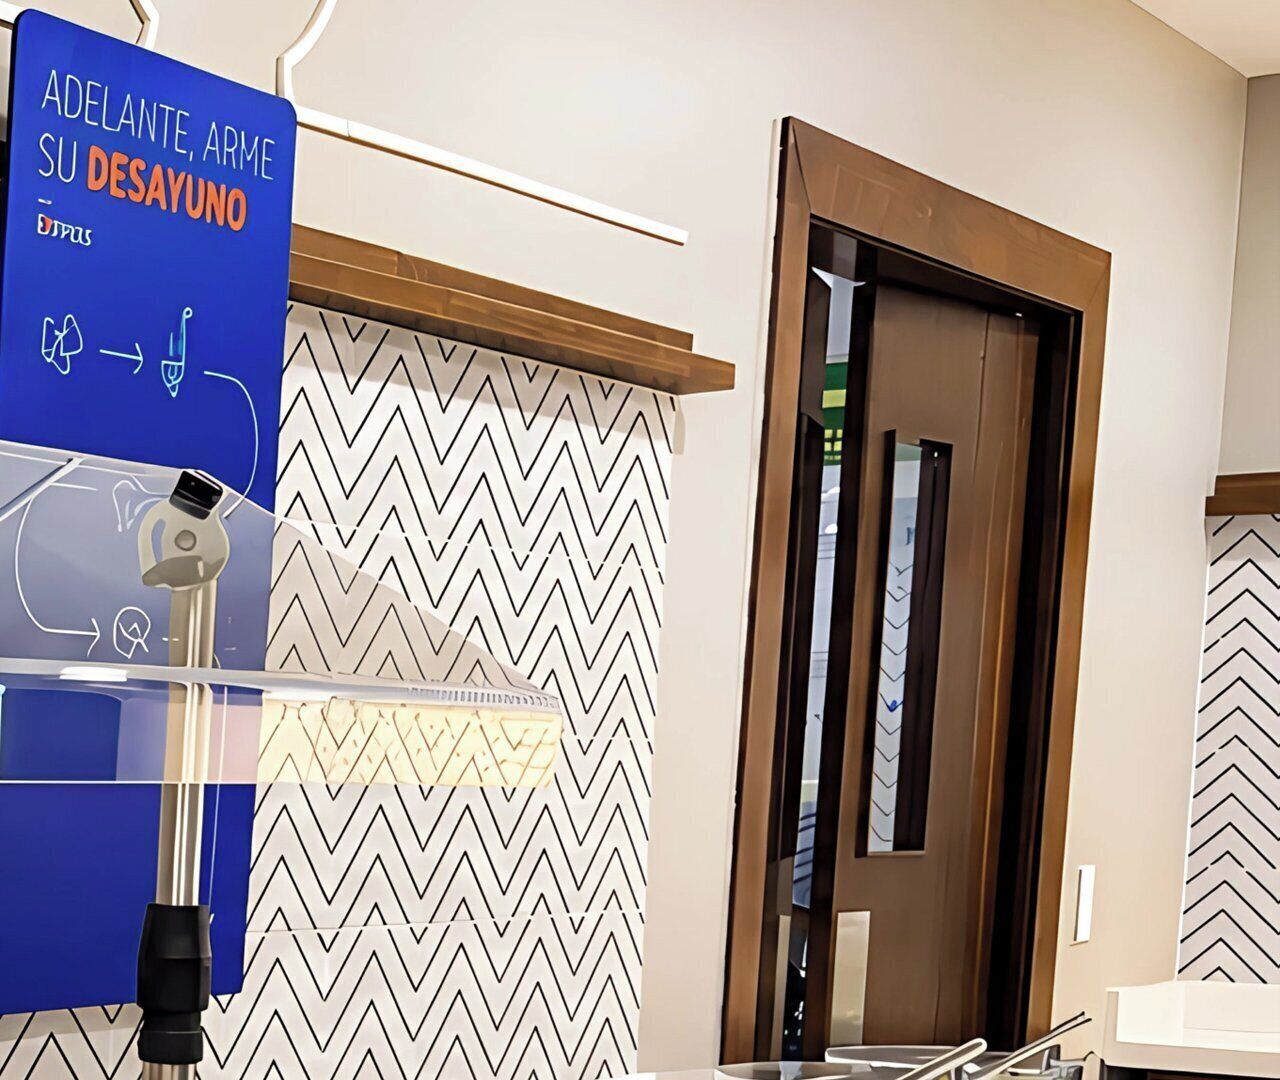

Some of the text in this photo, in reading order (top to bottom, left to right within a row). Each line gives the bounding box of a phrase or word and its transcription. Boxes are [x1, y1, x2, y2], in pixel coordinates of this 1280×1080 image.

[41, 69, 276, 181] ADELANTE, ARME
[38, 132, 78, 183] SU
[87, 144, 247, 232] DESAYUNO
